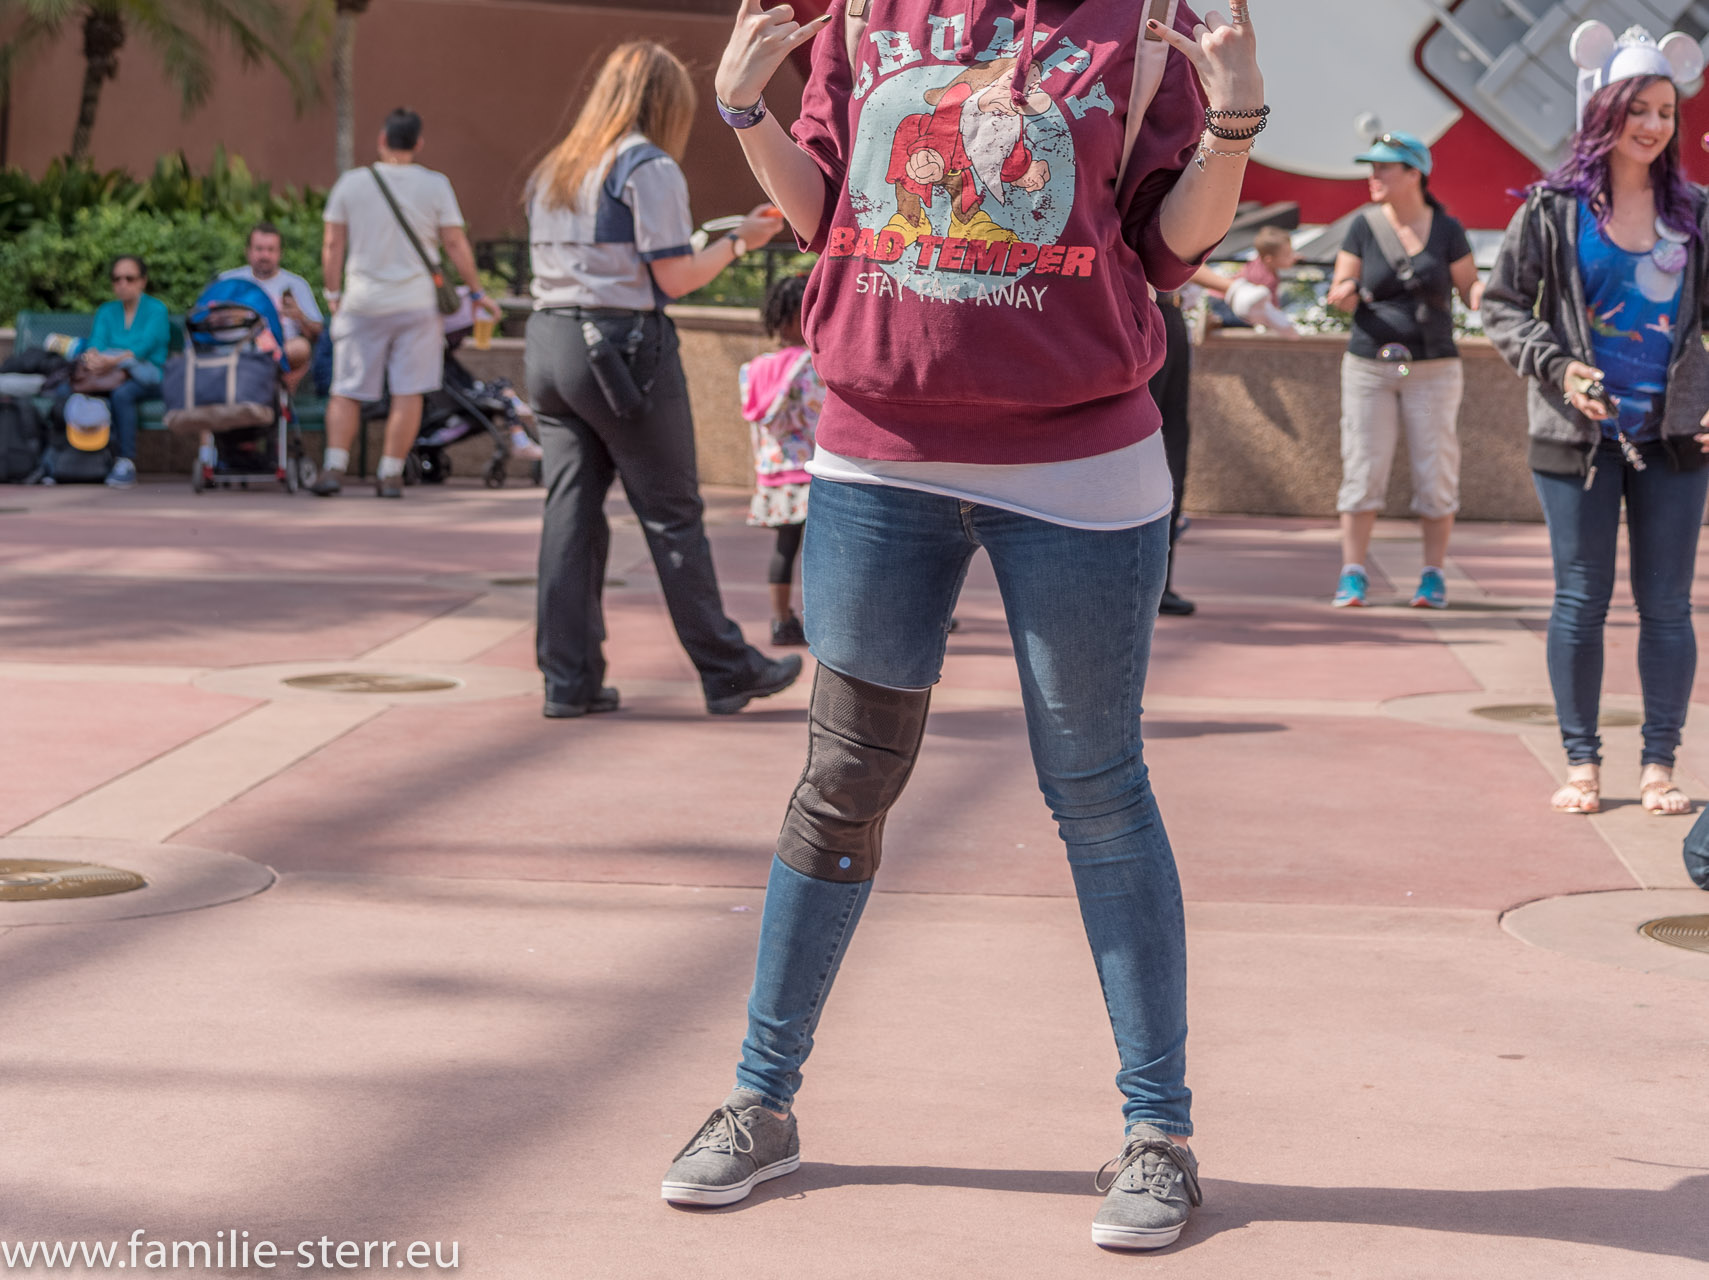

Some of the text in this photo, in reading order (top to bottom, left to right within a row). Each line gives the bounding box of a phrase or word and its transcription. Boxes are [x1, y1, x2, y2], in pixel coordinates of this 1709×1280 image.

[828, 226, 1097, 284] BAD TEMPER
[856, 271, 1049, 312] STAY FAR AWAY
